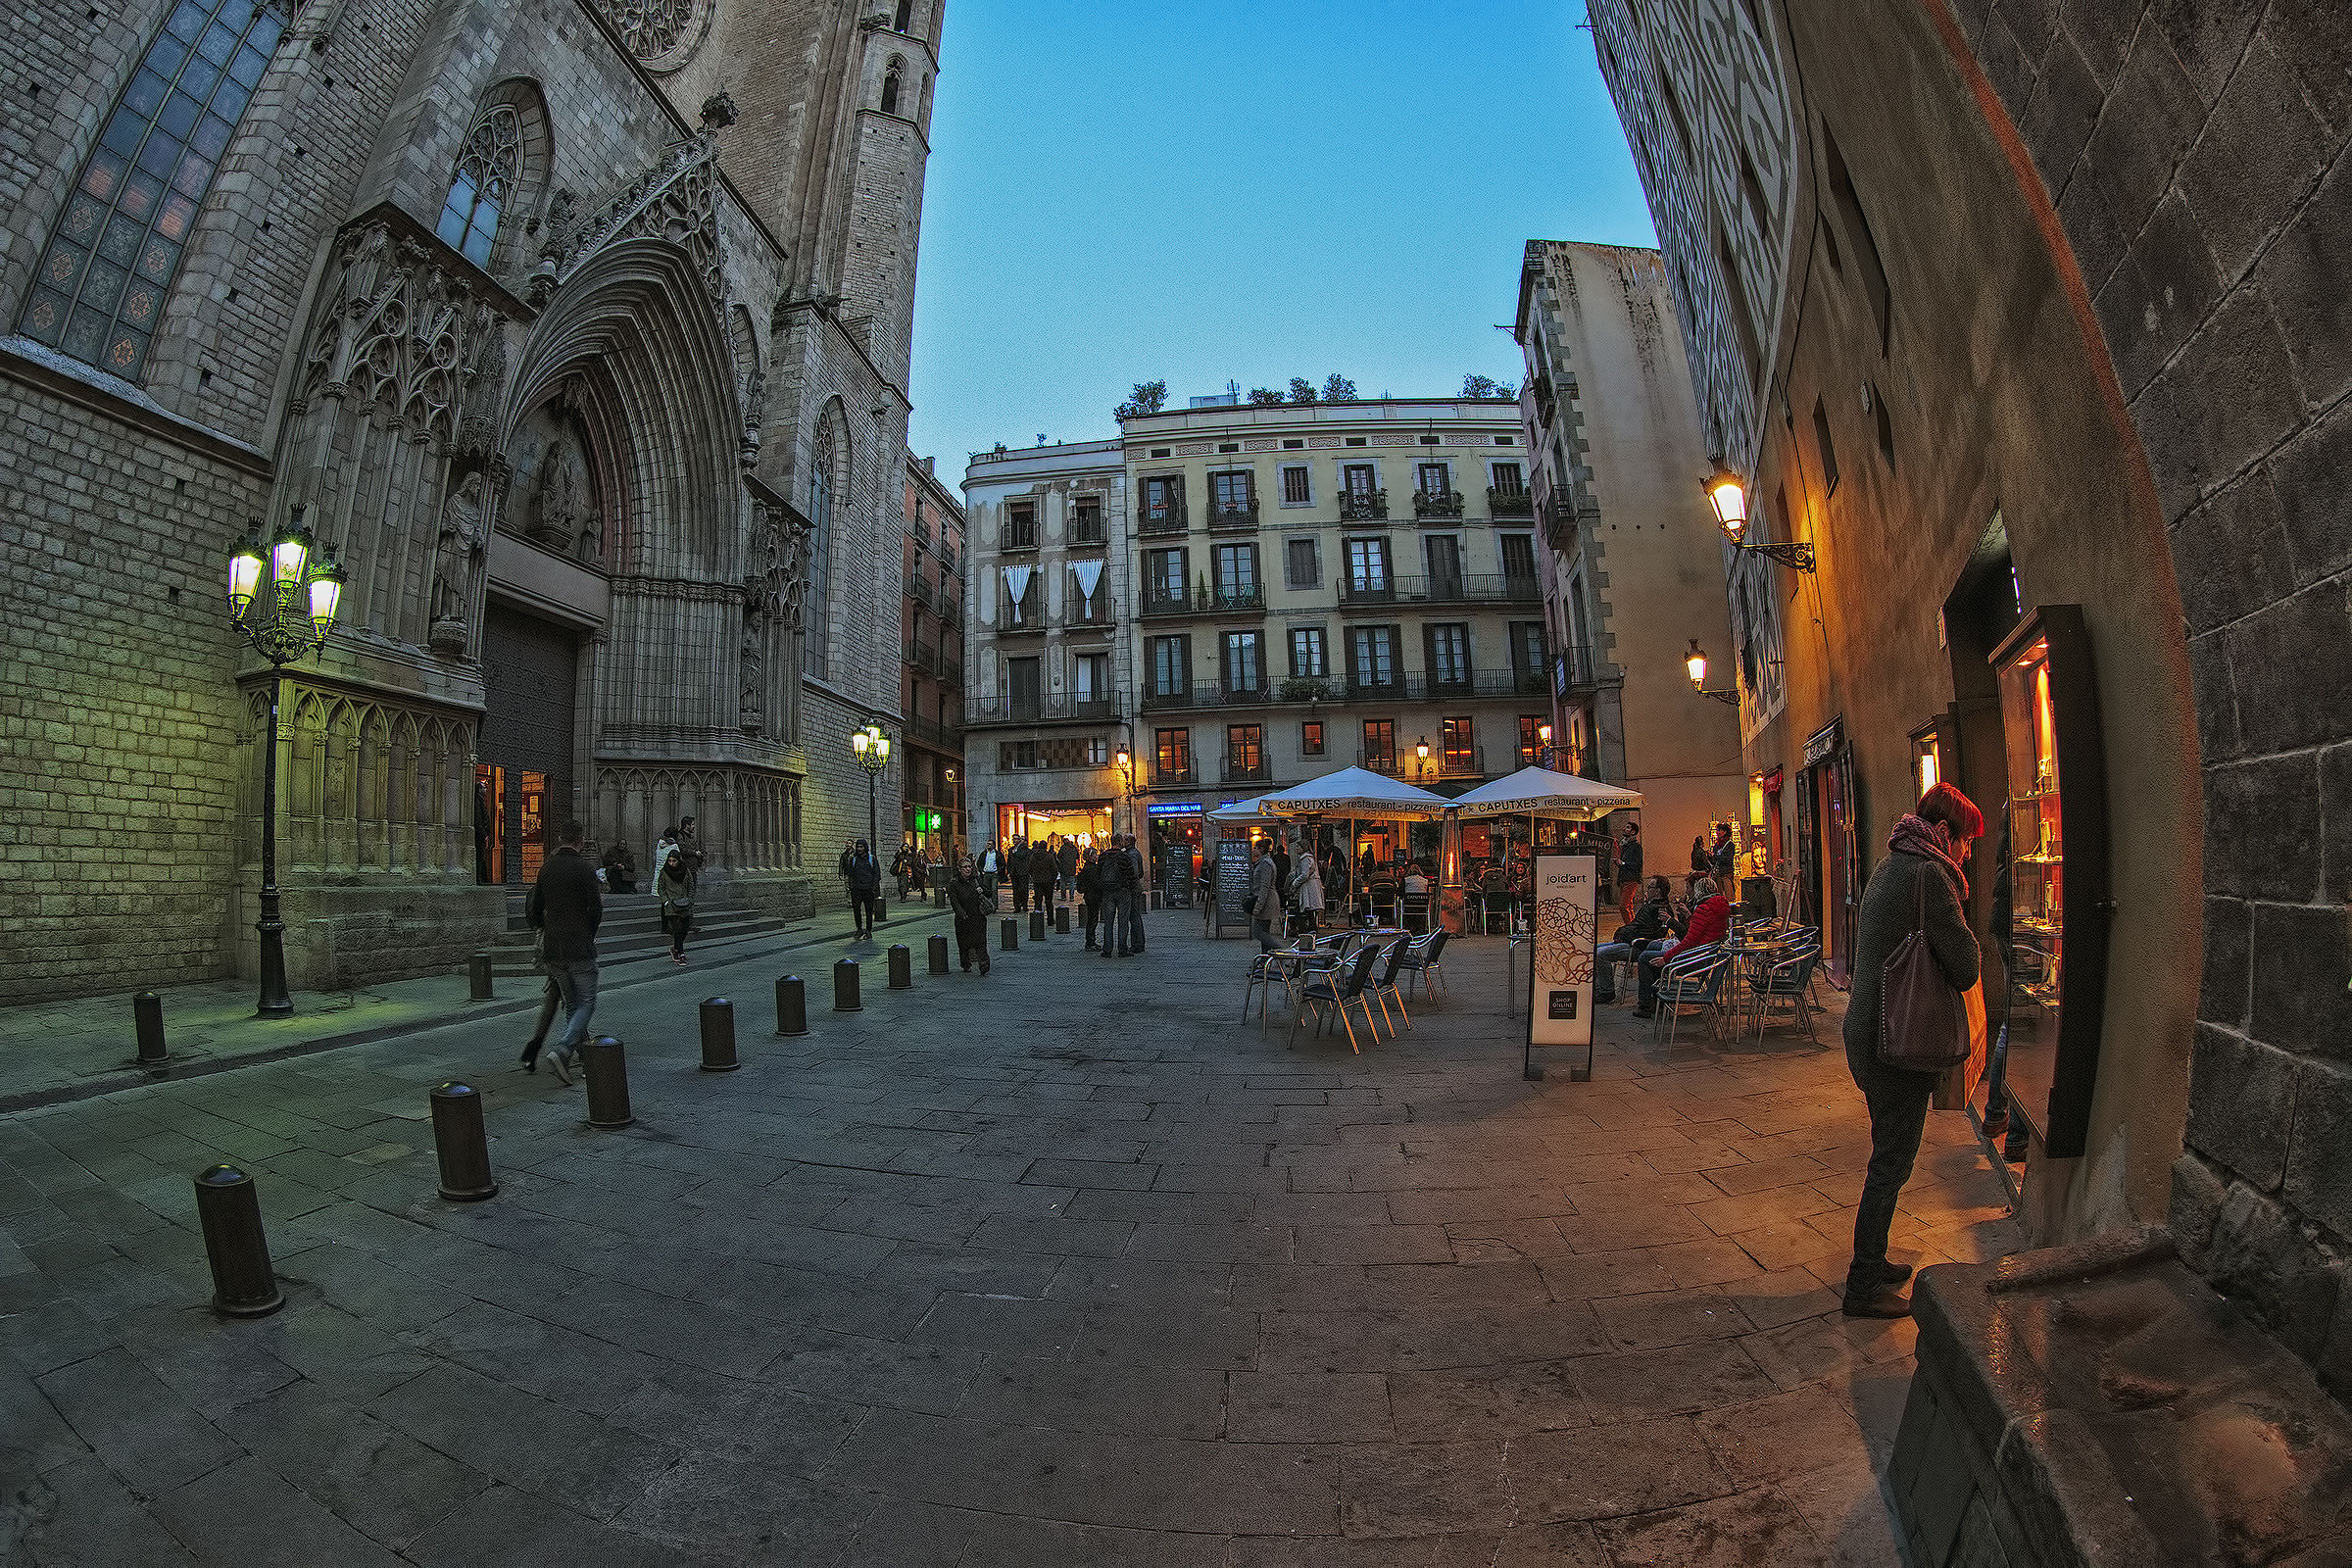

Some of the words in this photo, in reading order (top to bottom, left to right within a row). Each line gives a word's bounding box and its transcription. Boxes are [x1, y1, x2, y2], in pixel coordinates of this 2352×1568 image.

[1277, 799, 1341, 810] CAPUTXES
[1348, 800, 1396, 810] restaurant
[1404, 803, 1441, 812] pizzeria
[1478, 799, 1539, 812] CAPUTXES
[1544, 797, 1590, 807] restaurant
[1596, 797, 1631, 807] pizzeria
[1545, 873, 1587, 885] joid'art
